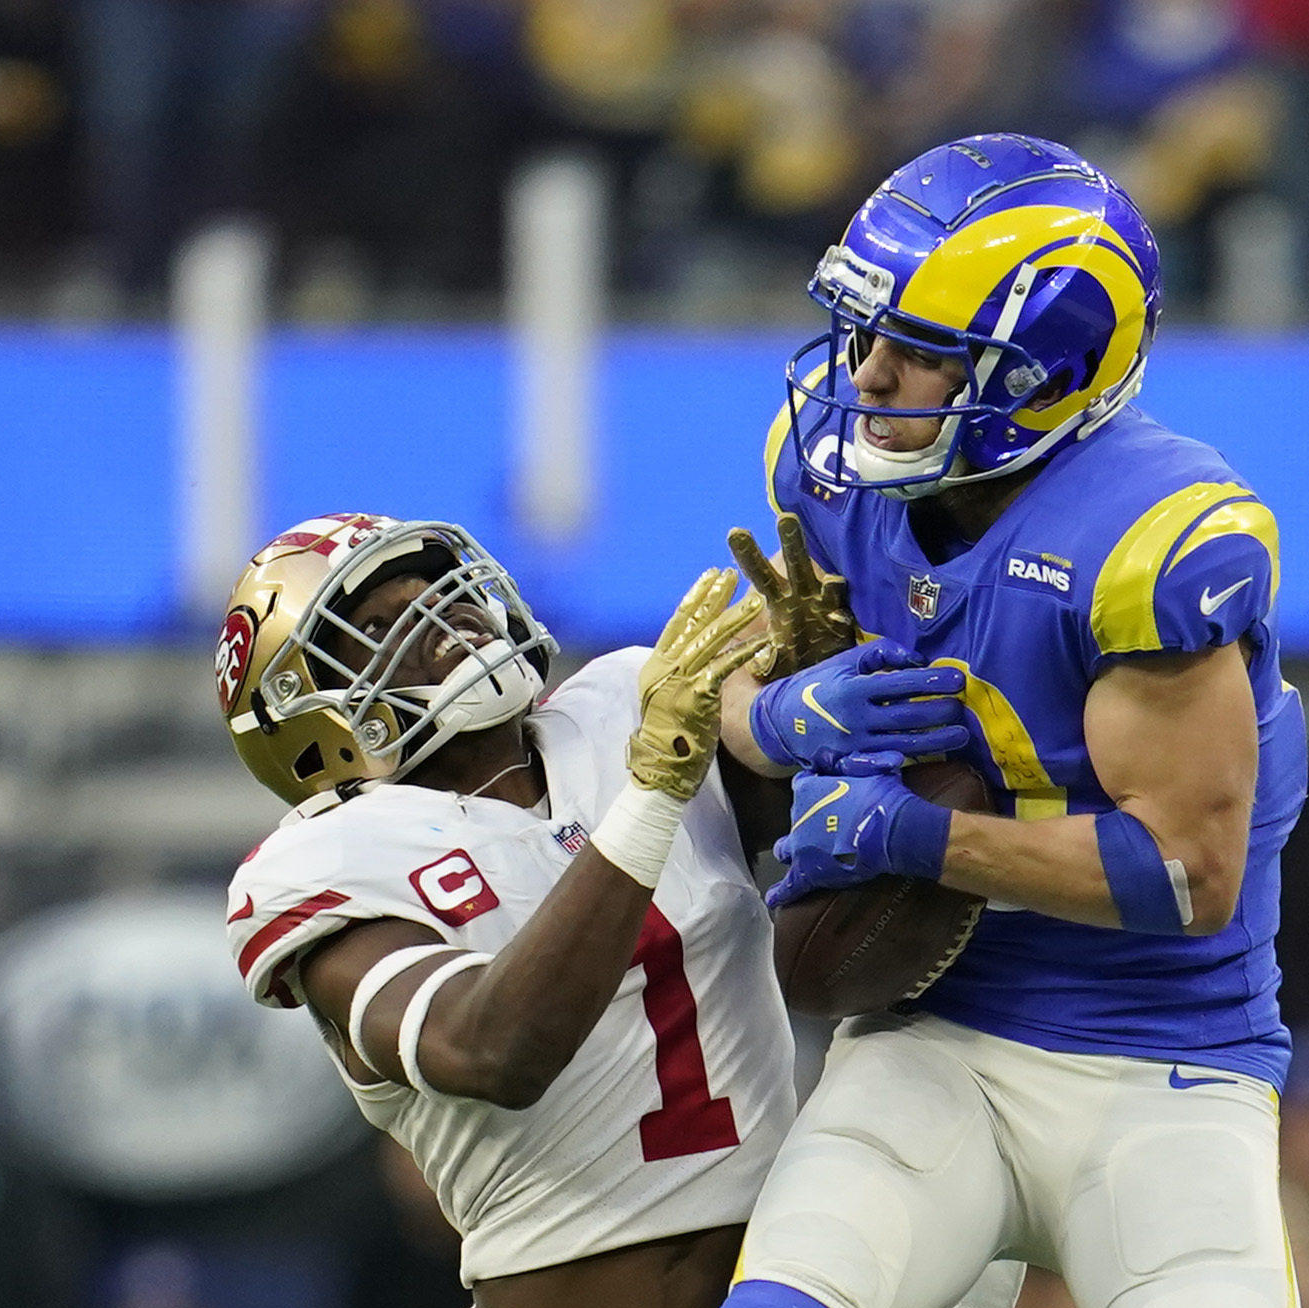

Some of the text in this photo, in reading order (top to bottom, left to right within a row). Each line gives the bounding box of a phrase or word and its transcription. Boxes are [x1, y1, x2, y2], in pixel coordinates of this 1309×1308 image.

[1007, 558, 1071, 592] RAMS
[564, 833, 588, 853] NFL
[827, 815, 839, 834] 10
[418, 856, 484, 911] C
[852, 908, 895, 958] FOOTBALL
[626, 899, 741, 1163] 1
